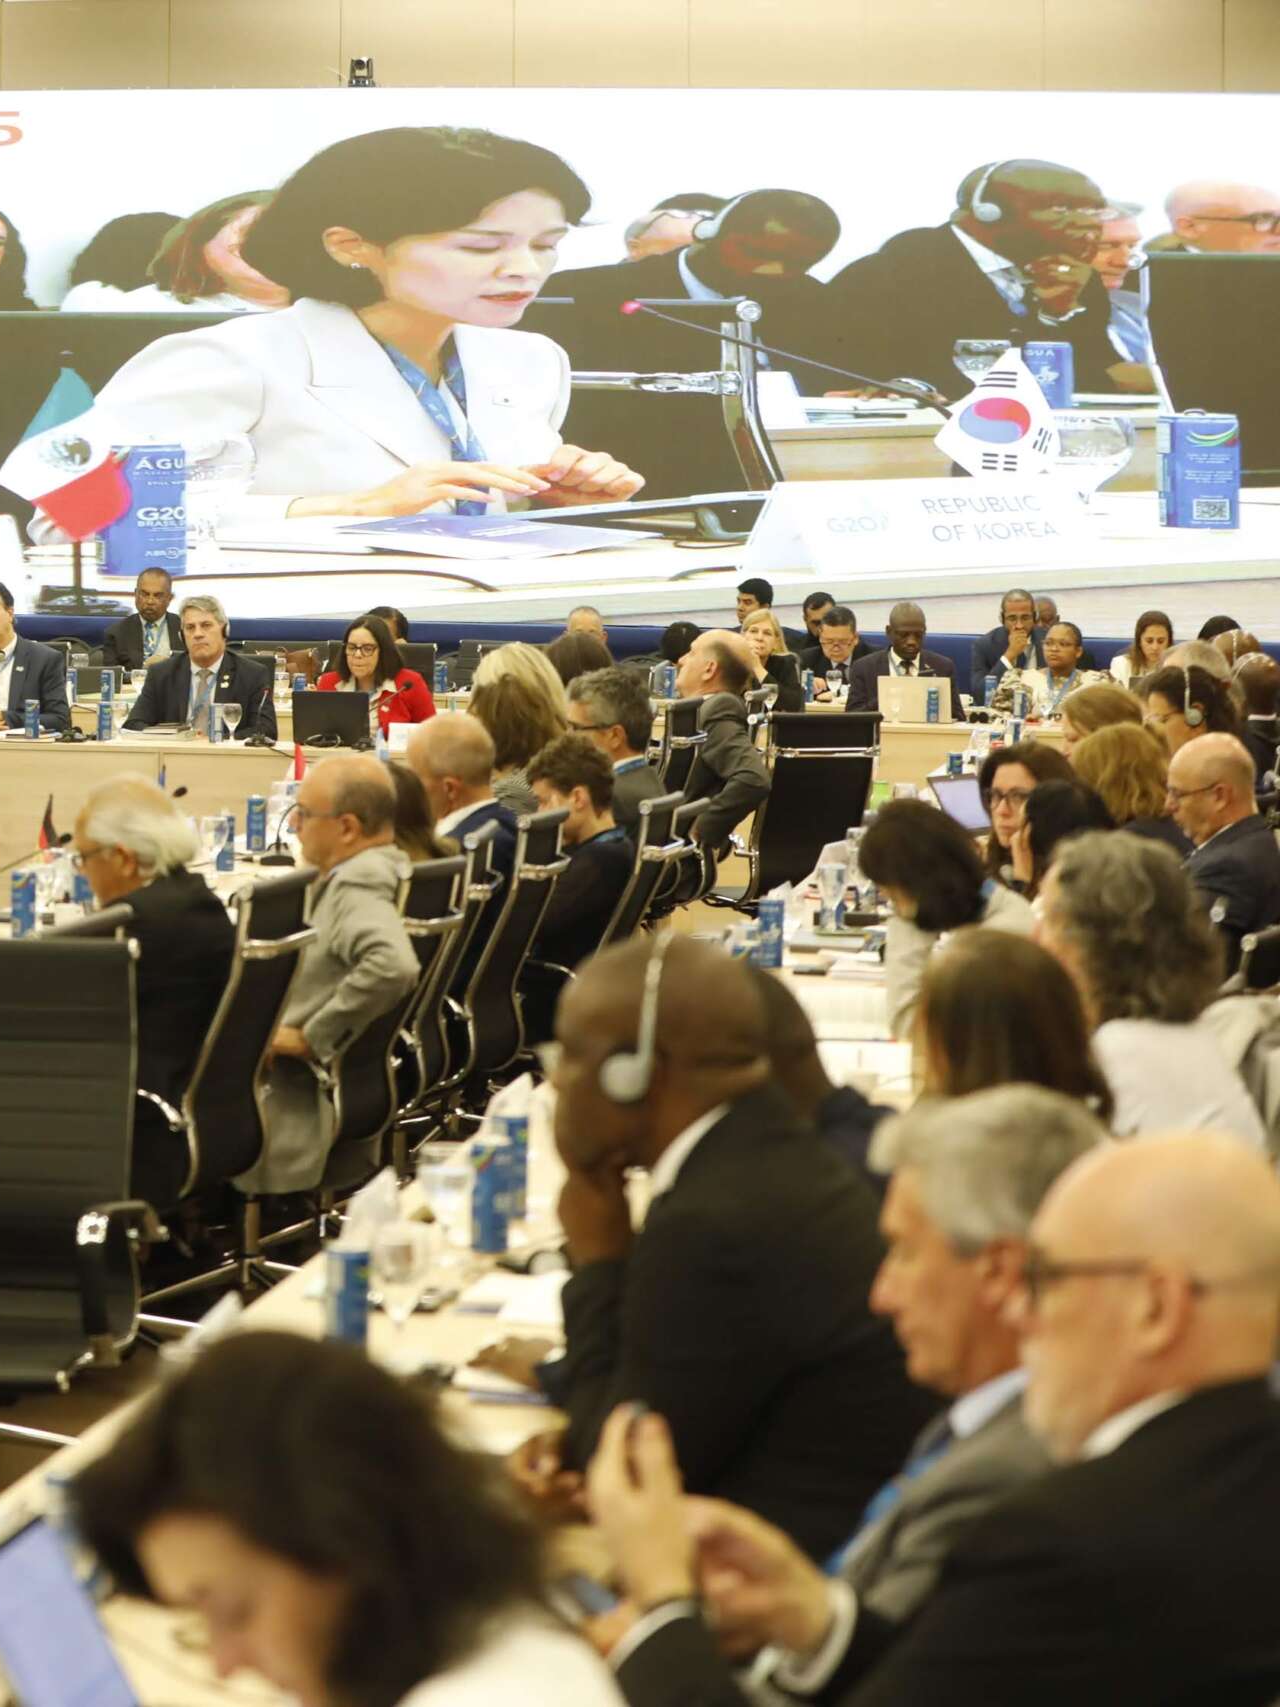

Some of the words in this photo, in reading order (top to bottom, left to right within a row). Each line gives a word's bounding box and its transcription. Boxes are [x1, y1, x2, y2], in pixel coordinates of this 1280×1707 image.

[135, 456, 184, 470] ÁGU
[921, 495, 1041, 514] REPUBLIC
[931, 523, 969, 543] OF
[975, 520, 1059, 542] KOREA
